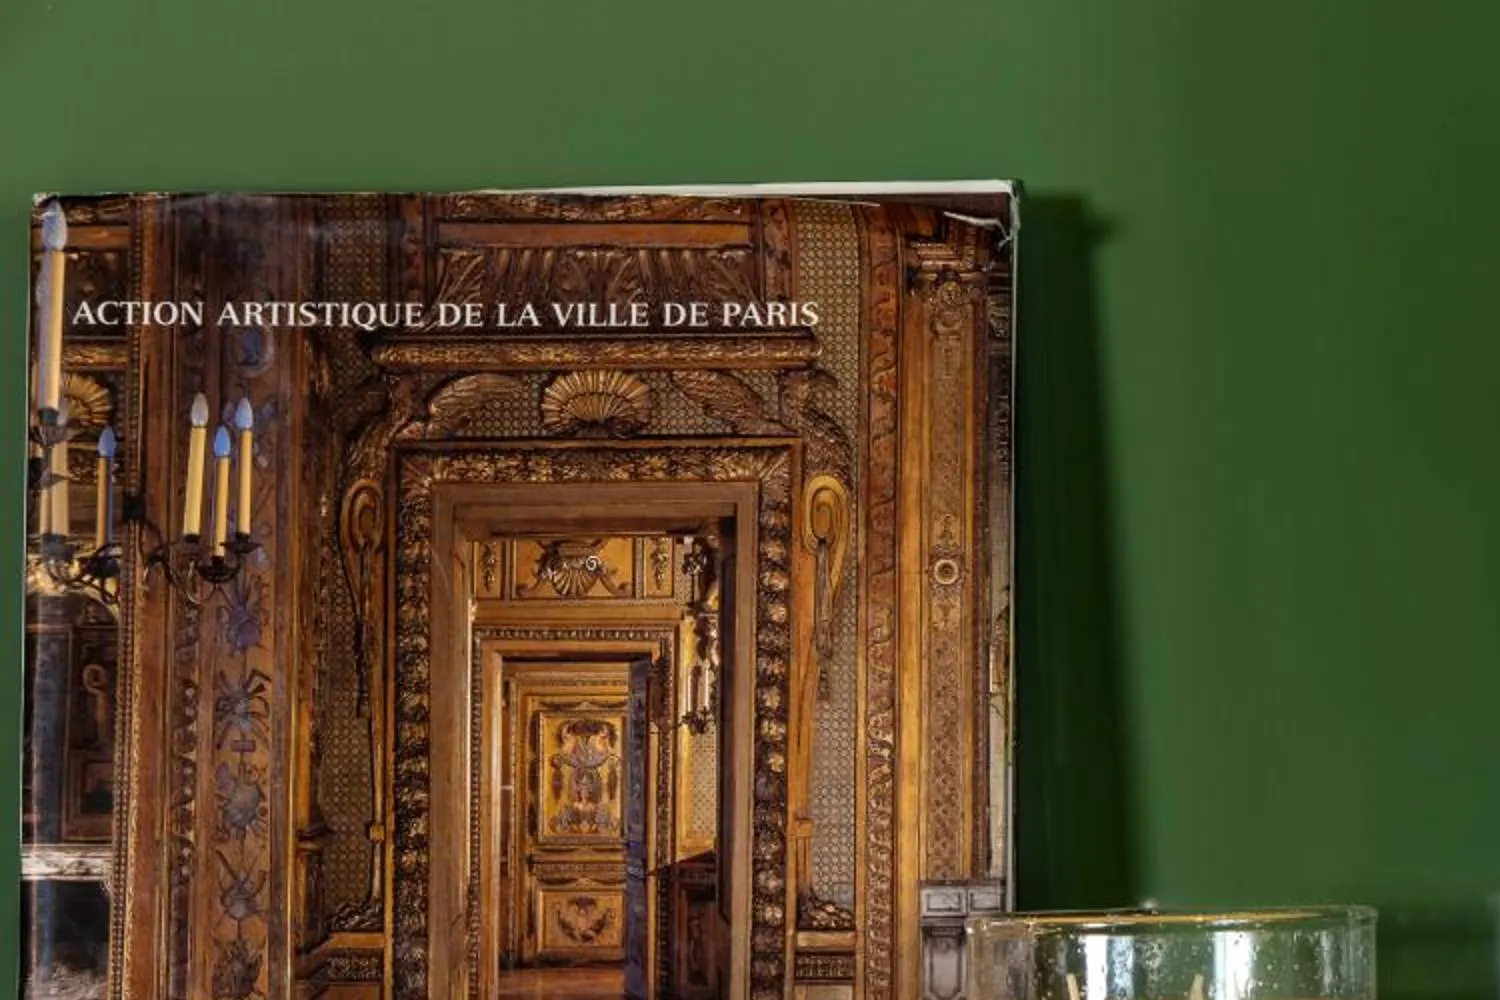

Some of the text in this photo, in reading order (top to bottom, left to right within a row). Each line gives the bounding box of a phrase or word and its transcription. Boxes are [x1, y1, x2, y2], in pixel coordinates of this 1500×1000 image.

[72, 301, 820, 331] ACTION ARTISTIQUE DE LA VILLE DE PARIS
